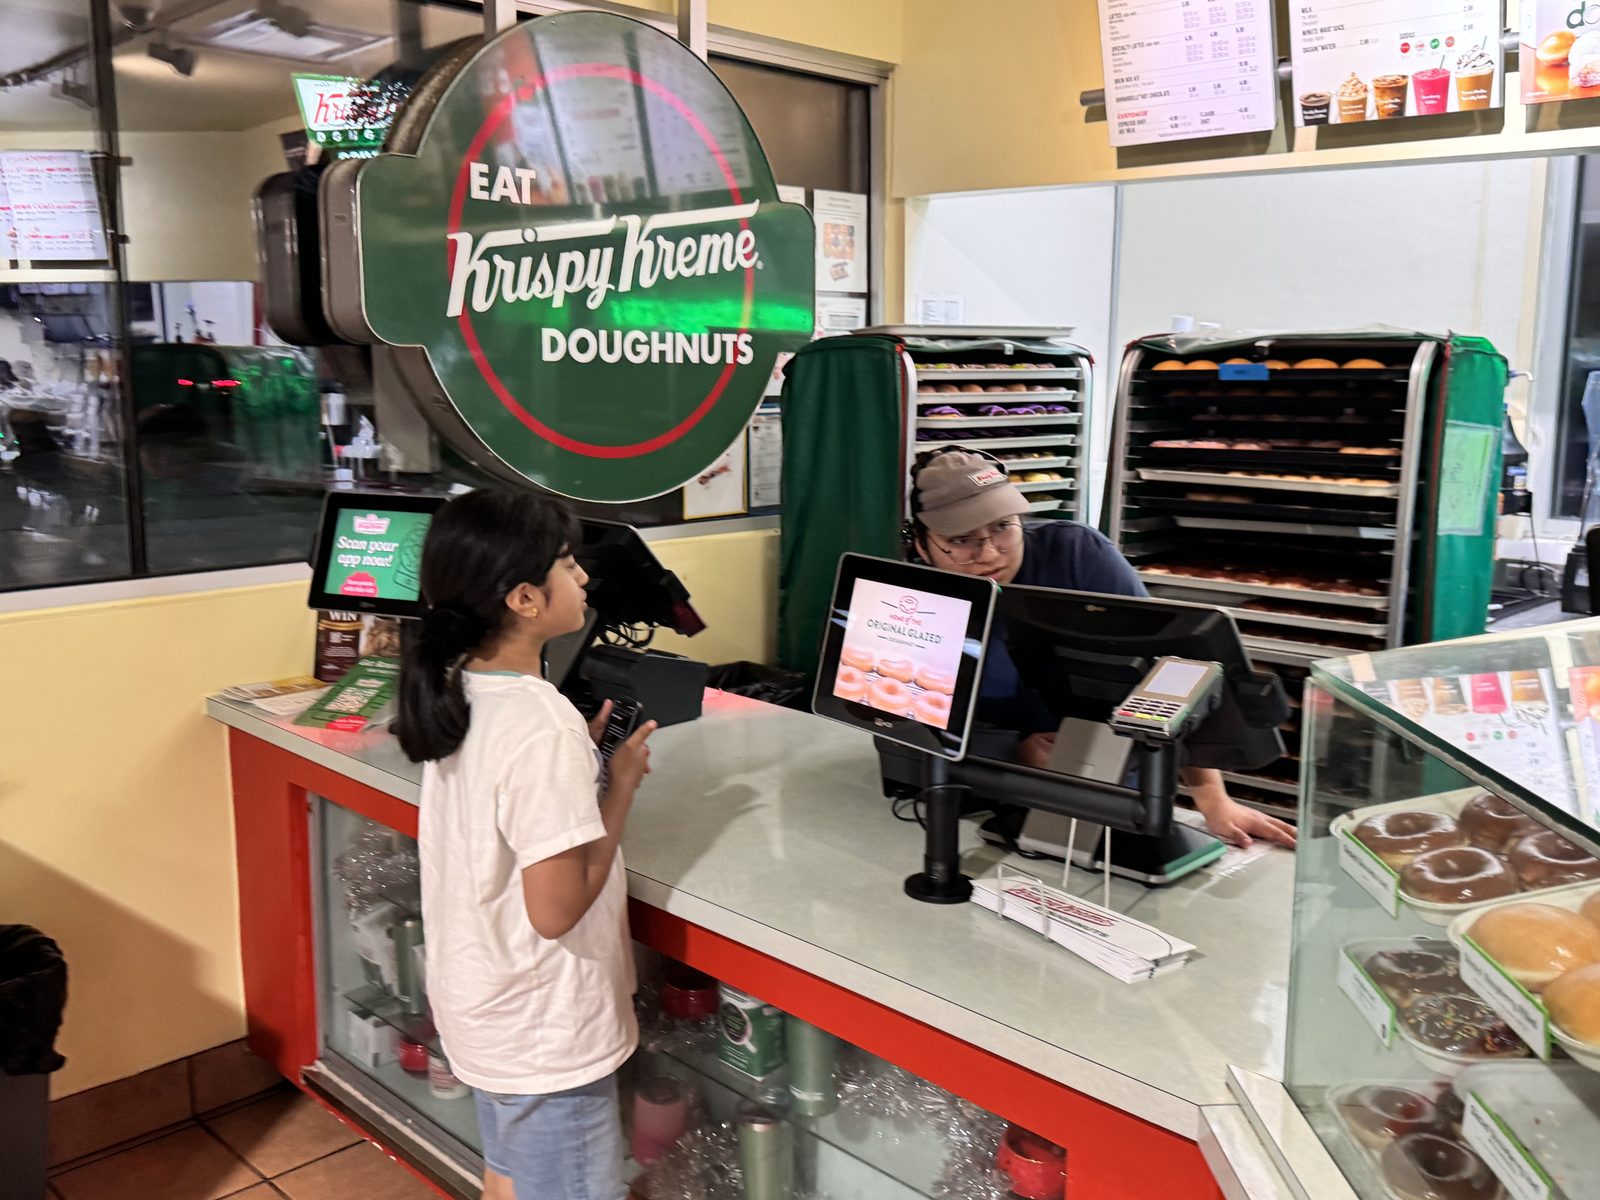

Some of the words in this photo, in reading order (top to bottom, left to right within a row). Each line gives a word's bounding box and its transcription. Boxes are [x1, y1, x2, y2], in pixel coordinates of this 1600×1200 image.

[470, 161, 537, 204] EAT
[446, 214, 617, 318] Krispy
[617, 199, 764, 292] Kreme
[541, 327, 754, 365] DOUGHNUTS
[337, 536, 368, 550] Scan
[367, 540, 399, 554] your
[337, 554, 361, 568] app
[362, 554, 393, 567] now!
[328, 610, 358, 622] WIN
[867, 618, 907, 637] ORIGINAL
